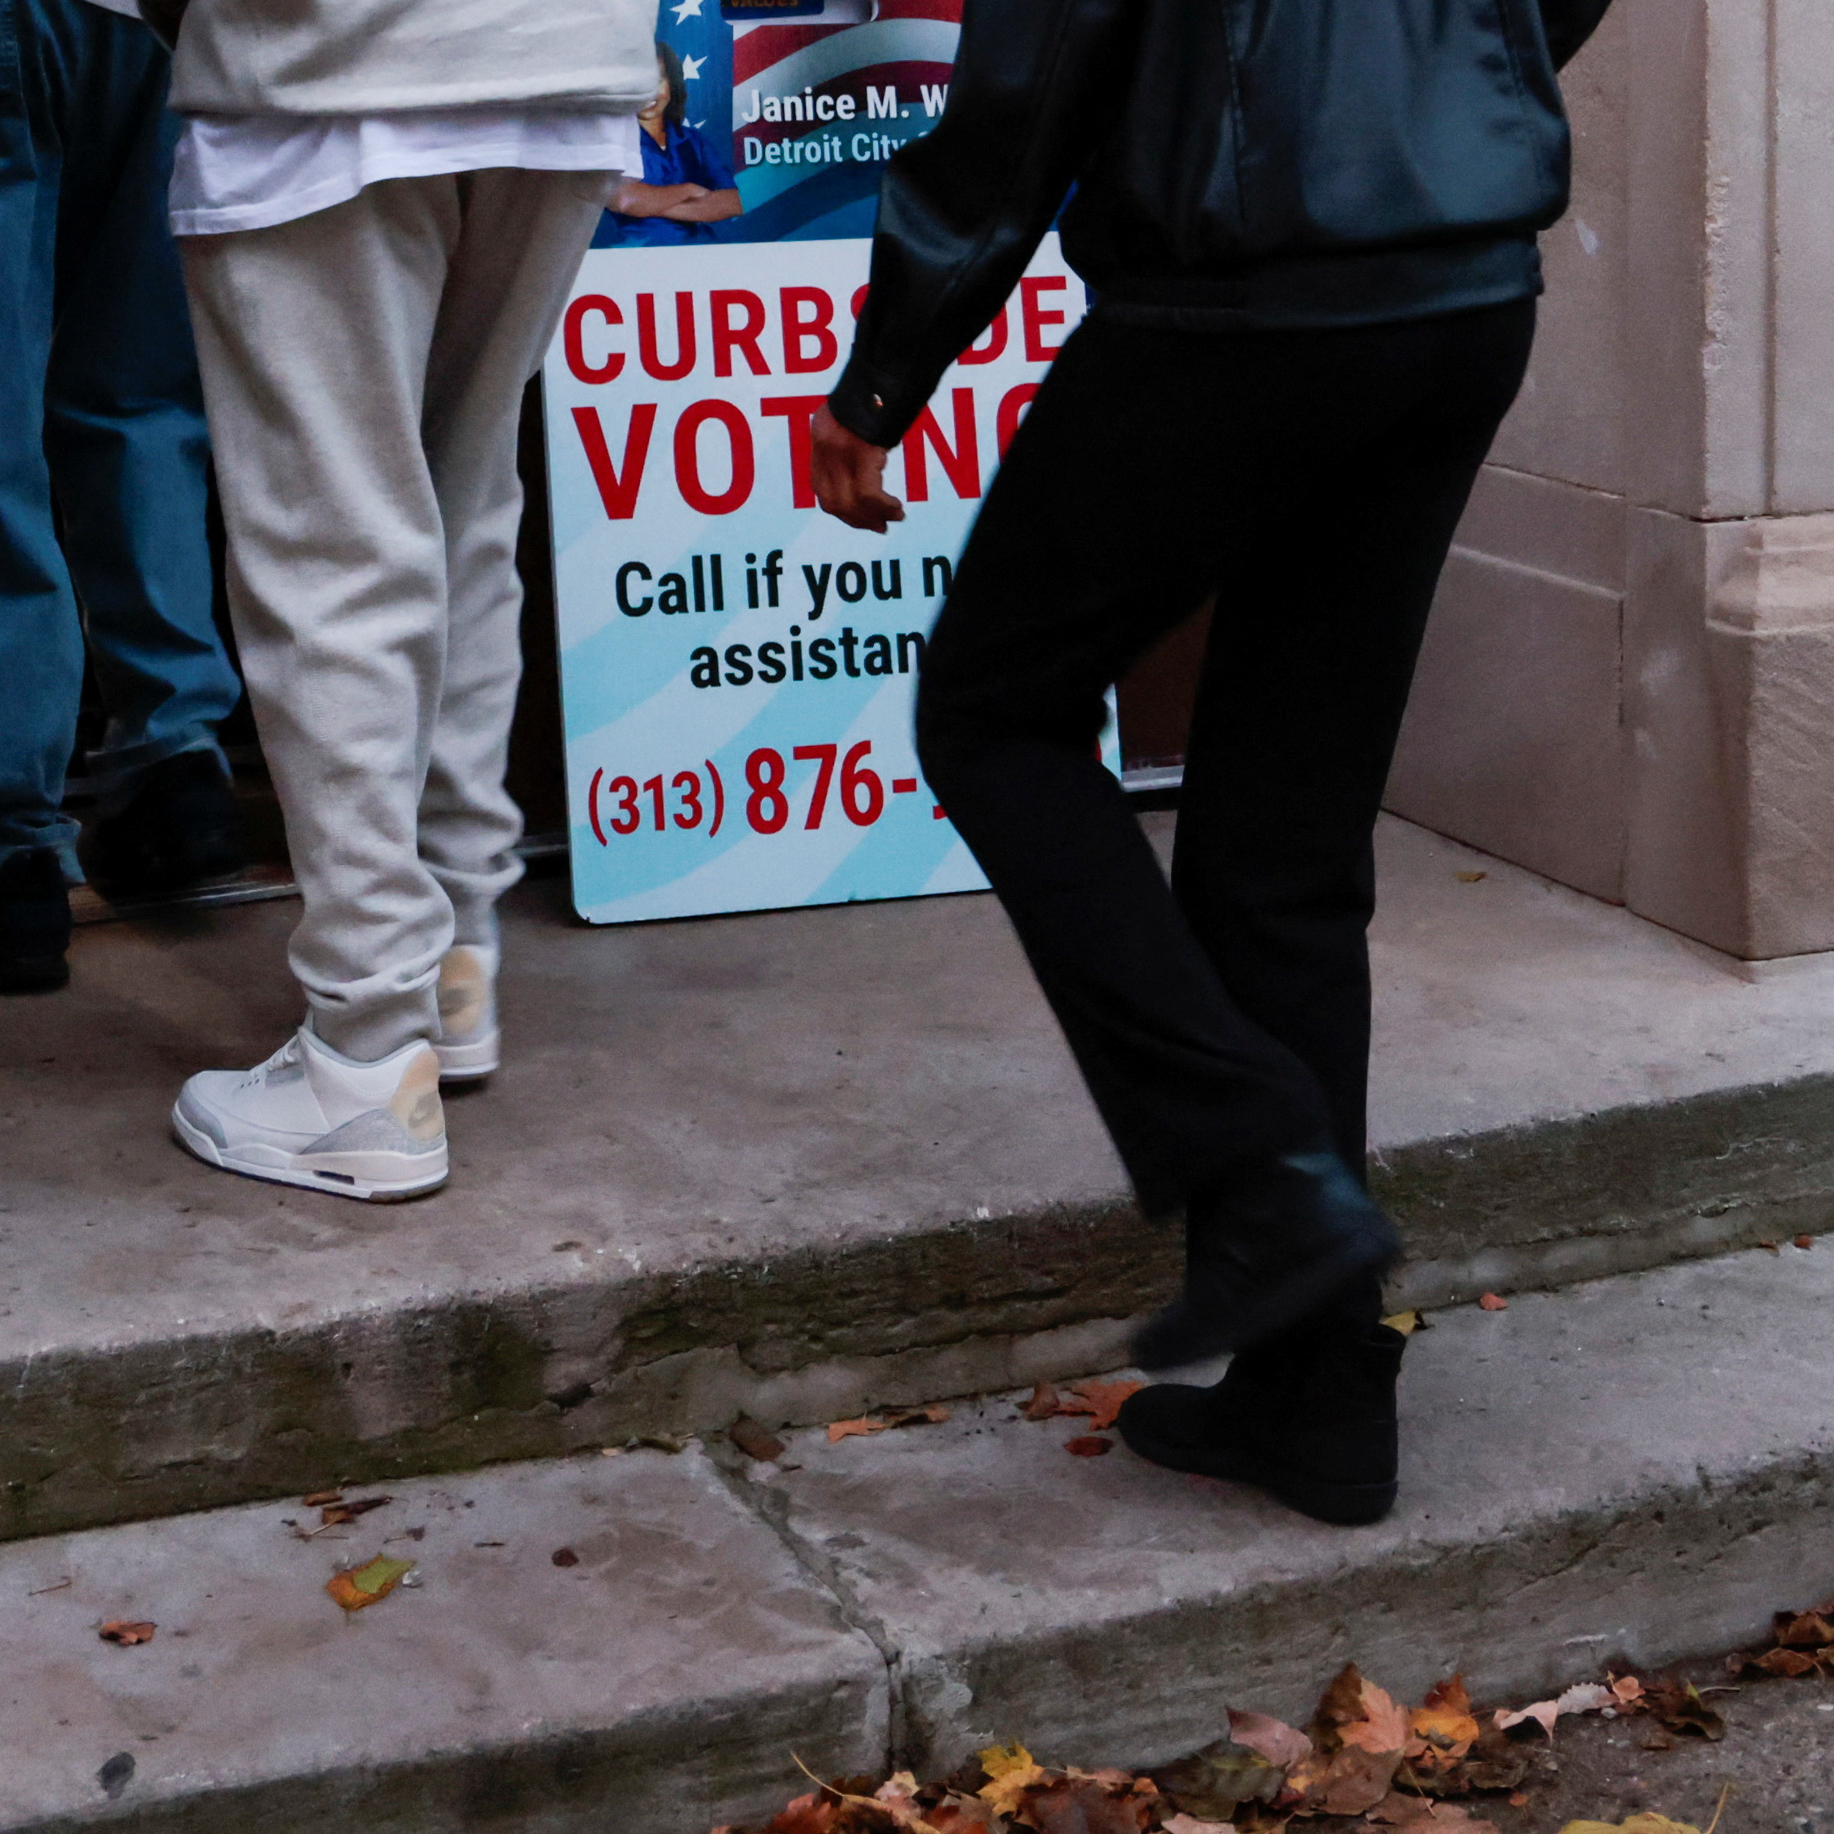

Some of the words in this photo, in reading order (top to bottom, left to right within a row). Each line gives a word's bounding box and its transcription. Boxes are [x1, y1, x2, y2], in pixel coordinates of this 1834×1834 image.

[742, 86, 856, 123] Janice
[866, 85, 909, 120] M.
[919, 83, 950, 118] W
[744, 133, 843, 165] Detroit
[616, 553, 723, 617] Call
[745, 550, 784, 610] if
[802, 556, 902, 620] you
[690, 626, 929, 688] assistan
[588, 759, 724, 847] (313)
[745, 739, 949, 835] 876-
